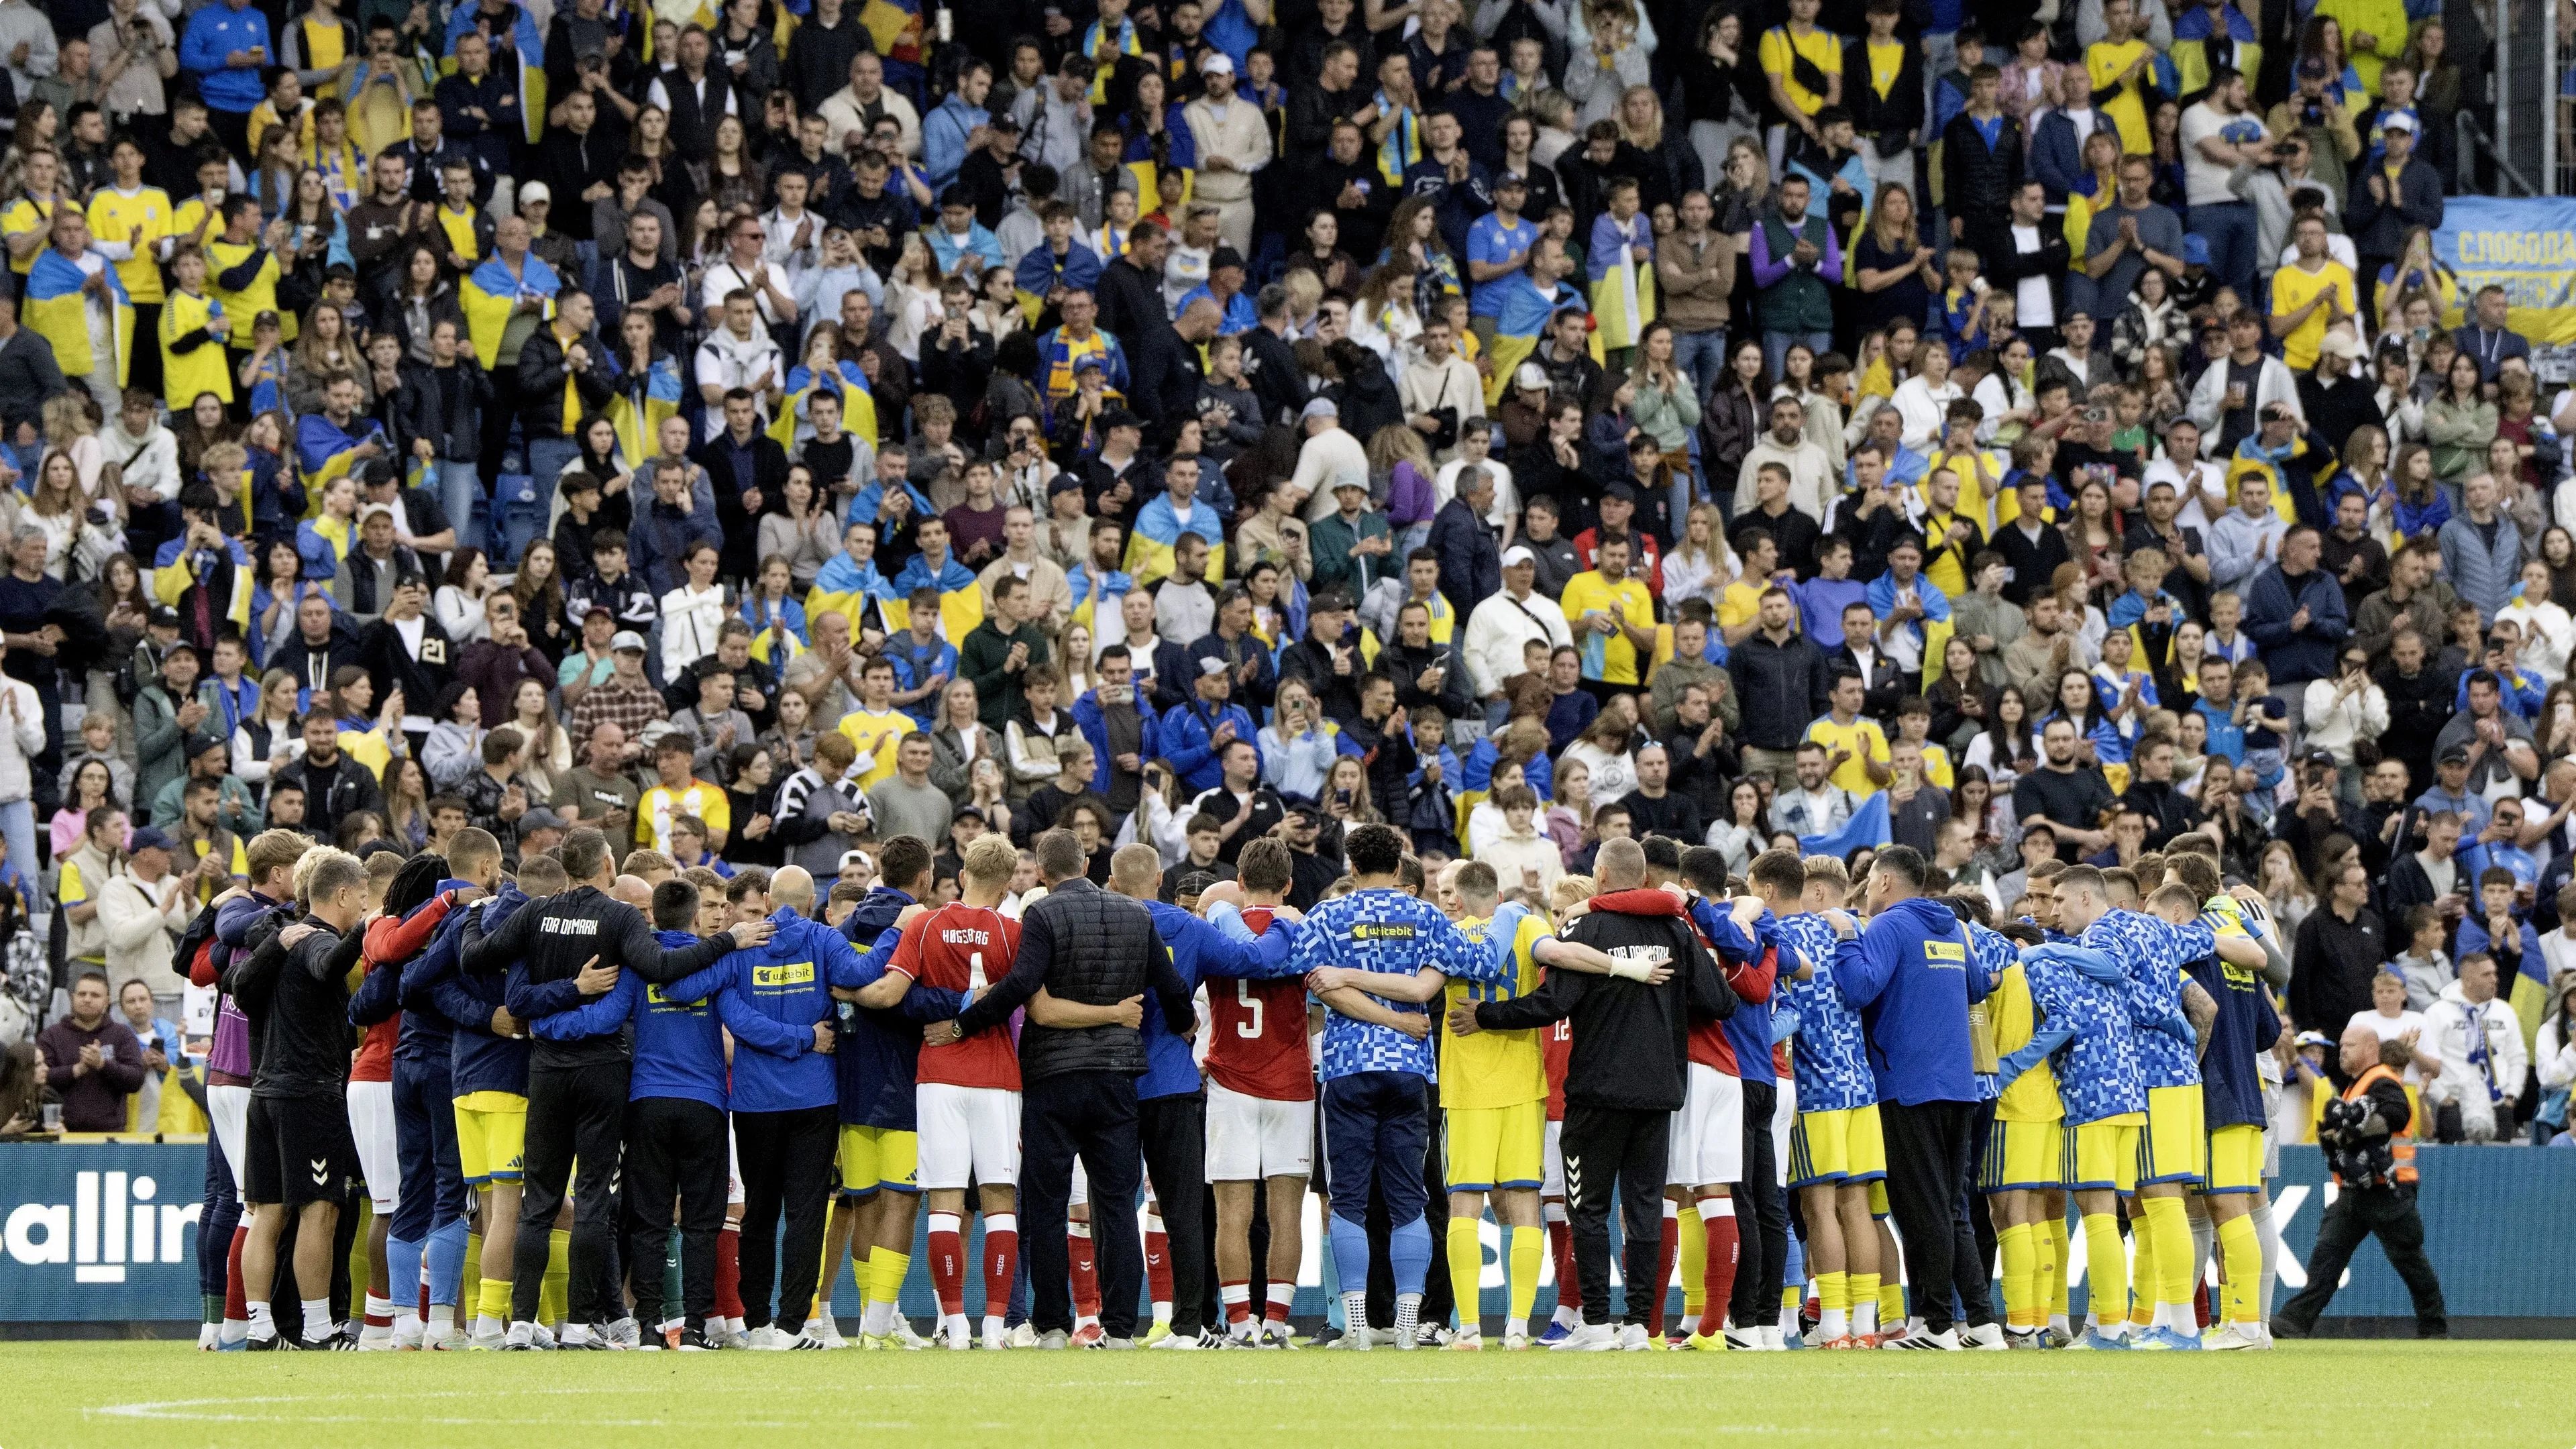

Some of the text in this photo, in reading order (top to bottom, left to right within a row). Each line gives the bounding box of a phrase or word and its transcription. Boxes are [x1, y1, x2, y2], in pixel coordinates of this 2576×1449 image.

[2459, 230, 2576, 266] СЛОБОДА
[421, 638, 446, 665] 21
[540, 916, 598, 935] FOR DMARK
[942, 928, 989, 946] HØGSBRG
[1237, 979, 1263, 1038] 5
[1554, 1016, 1570, 1041] 12
[0, 1171, 205, 1266] allin
